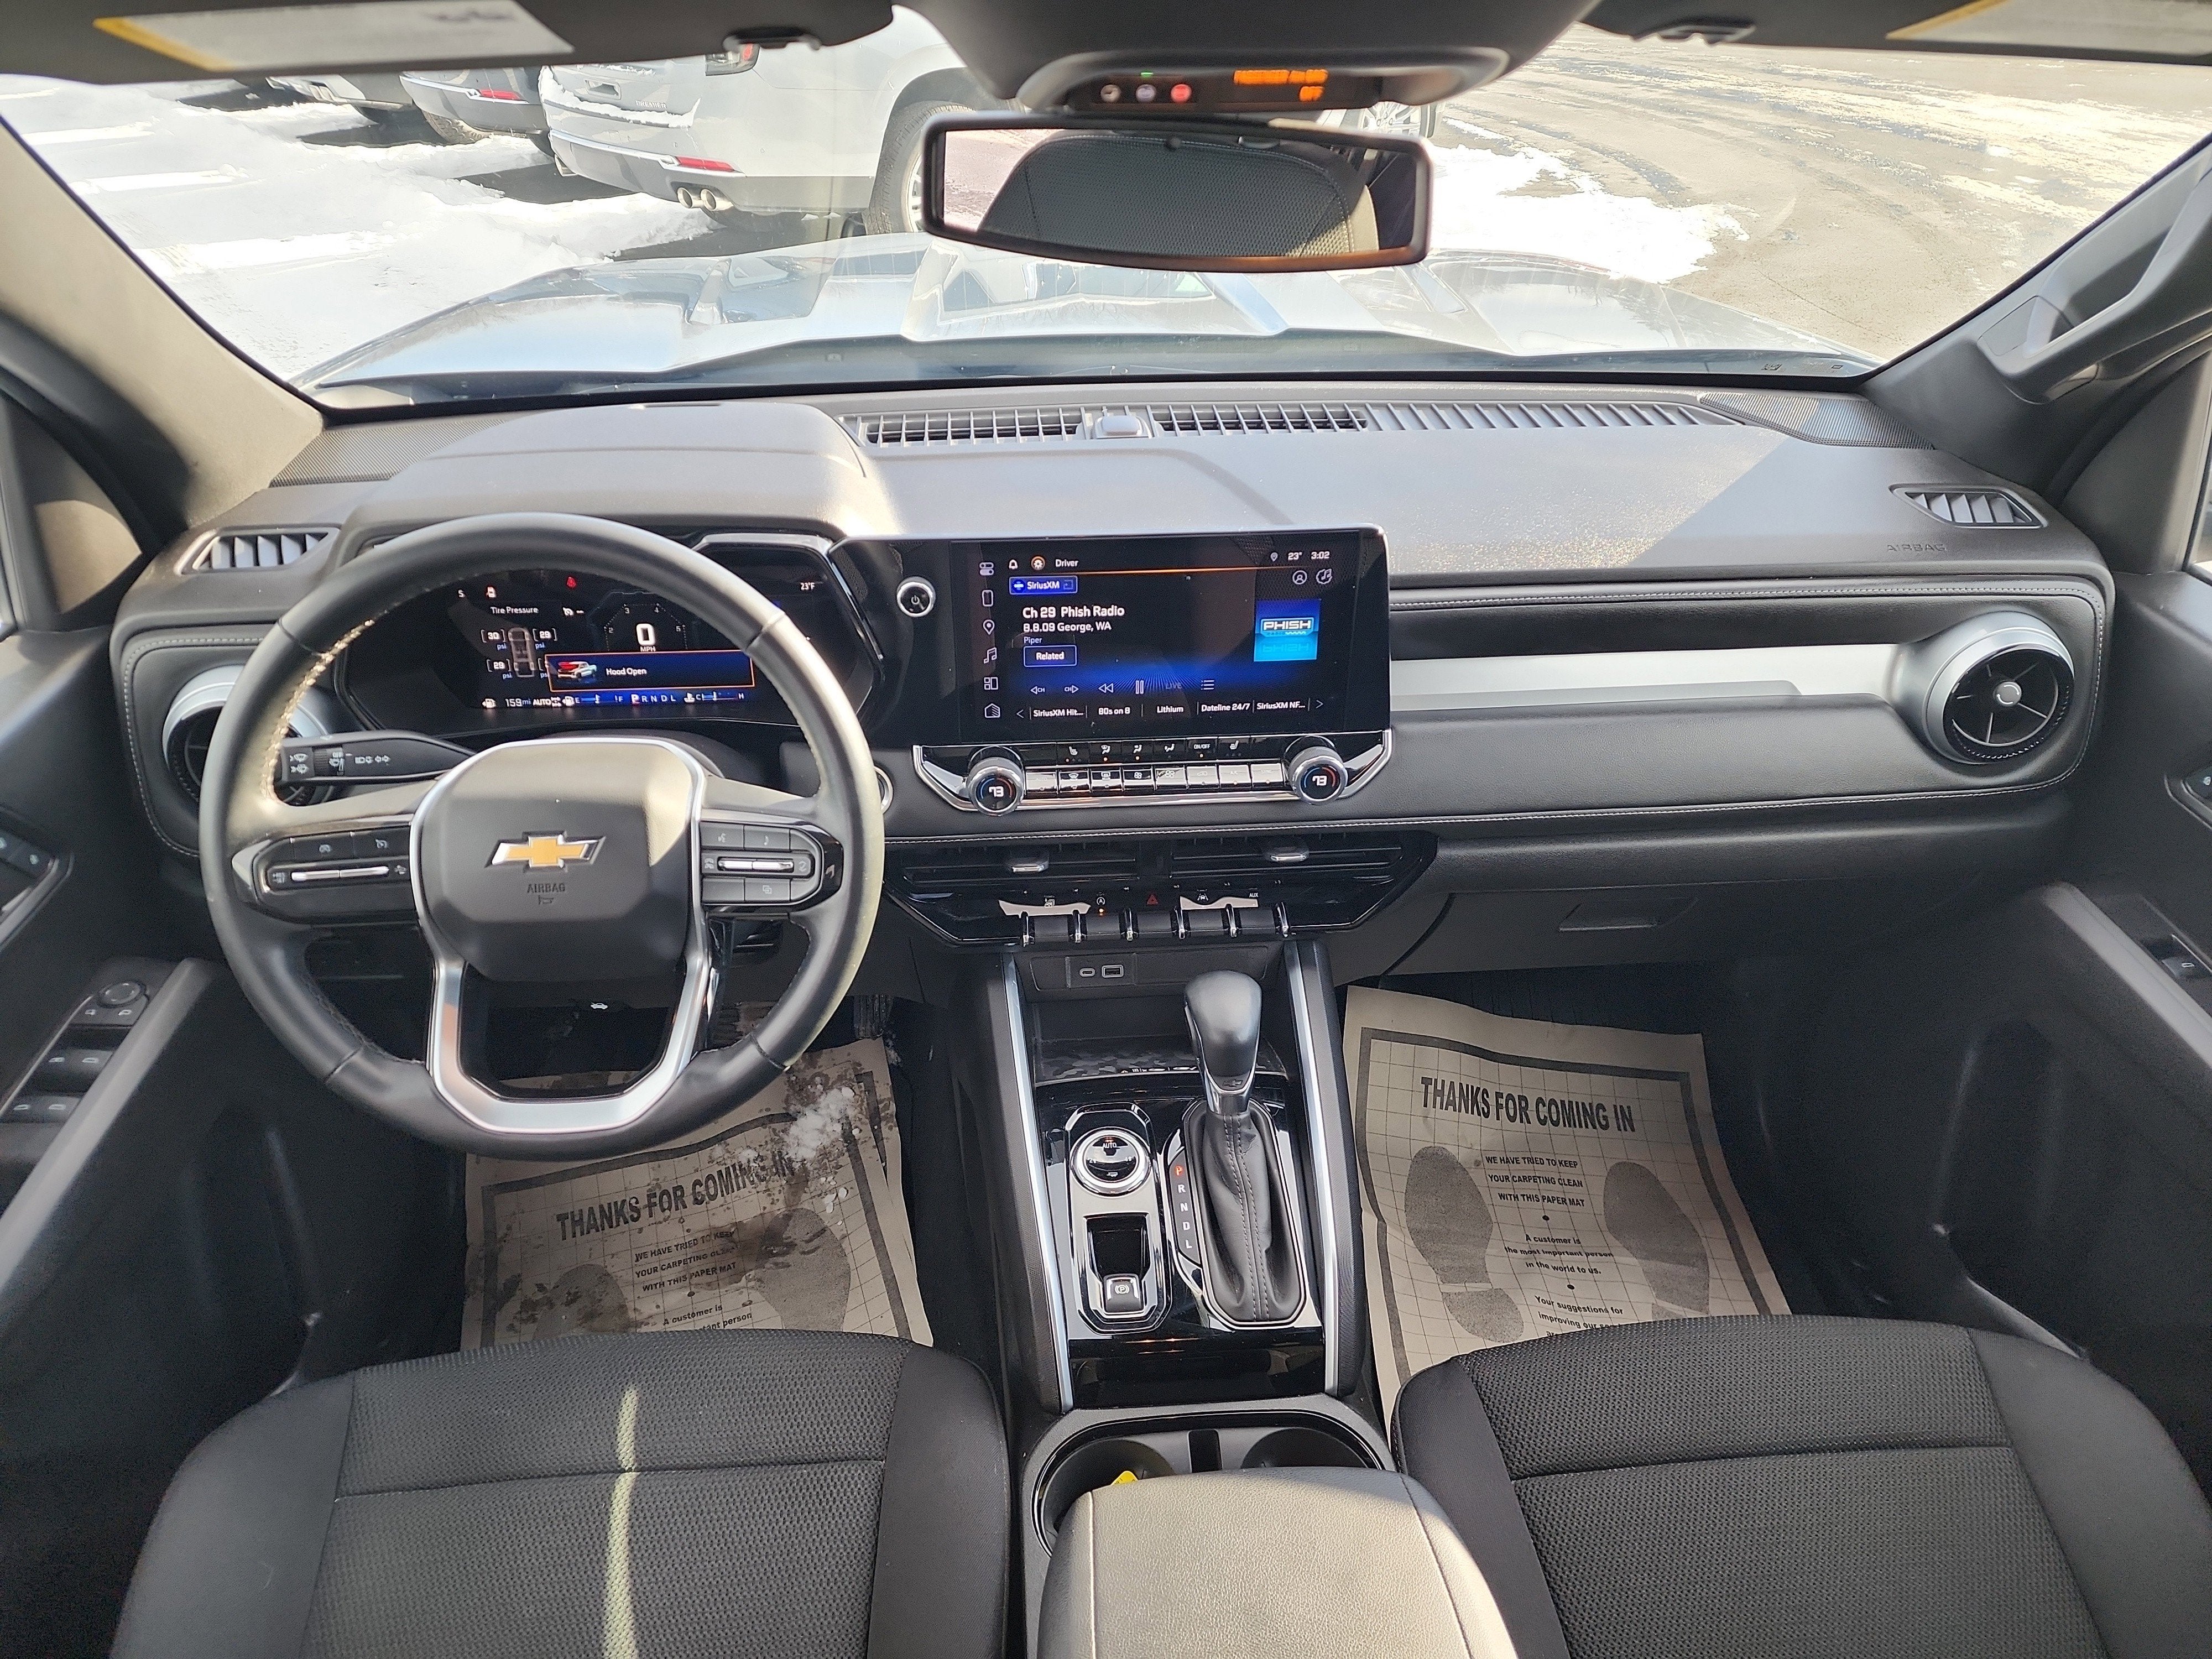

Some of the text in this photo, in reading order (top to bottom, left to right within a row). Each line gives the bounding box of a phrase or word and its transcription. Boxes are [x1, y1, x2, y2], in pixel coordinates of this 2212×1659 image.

[1055, 559, 1078, 567] Driver
[1027, 581, 1060, 589] SiriusXM
[1023, 605, 1125, 618] Ch 29 Phish Radio
[1023, 622, 1112, 633] 8.8.09 George, WA
[1264, 620, 1311, 630] PHISH
[487, 632, 500, 640] 30
[539, 630, 552, 639] 29
[637, 623, 655, 646] 0
[1024, 637, 1042, 645] Piper
[1036, 651, 1064, 660] Related
[627, 667, 647, 676] Open
[1256, 702, 1288, 710] SiriusXM
[1312, 775, 1327, 786] 73
[989, 786, 1004, 797] 73
[527, 883, 565, 893] AIRBAG
[1421, 1077, 1635, 1131] THANKS FOR COMING IN
[1546, 1158, 1556, 1166] TO
[1557, 1160, 1578, 1168] KEEP
[1512, 1175, 1556, 1185] CARPETING
[1558, 1178, 1583, 1187] CLEAN
[1498, 1193, 1584, 1207] WITH THIS PAPER MAT
[556, 1196, 641, 1240] THANKS
[646, 1185, 687, 1218] FOR
[1175, 1166, 1192, 1249] P R N D L
[635, 1251, 648, 1262] WE
[650, 1246, 672, 1257] HAVE
[674, 1239, 698, 1251] TRIED
[700, 1235, 711, 1243] TO
[635, 1266, 658, 1277] YOUR
[661, 1253, 708, 1271] CARPETING
[1551, 1265, 1575, 1273] world
[643, 1262, 736, 1291] WITH THIS PAPER MAT
[1535, 1296, 1554, 1306] Your
[1557, 1302, 1609, 1313] suggestions
[672, 1307, 713, 1323] customer
[723, 1313, 752, 1328] person
[1538, 1311, 1581, 1328] improving
